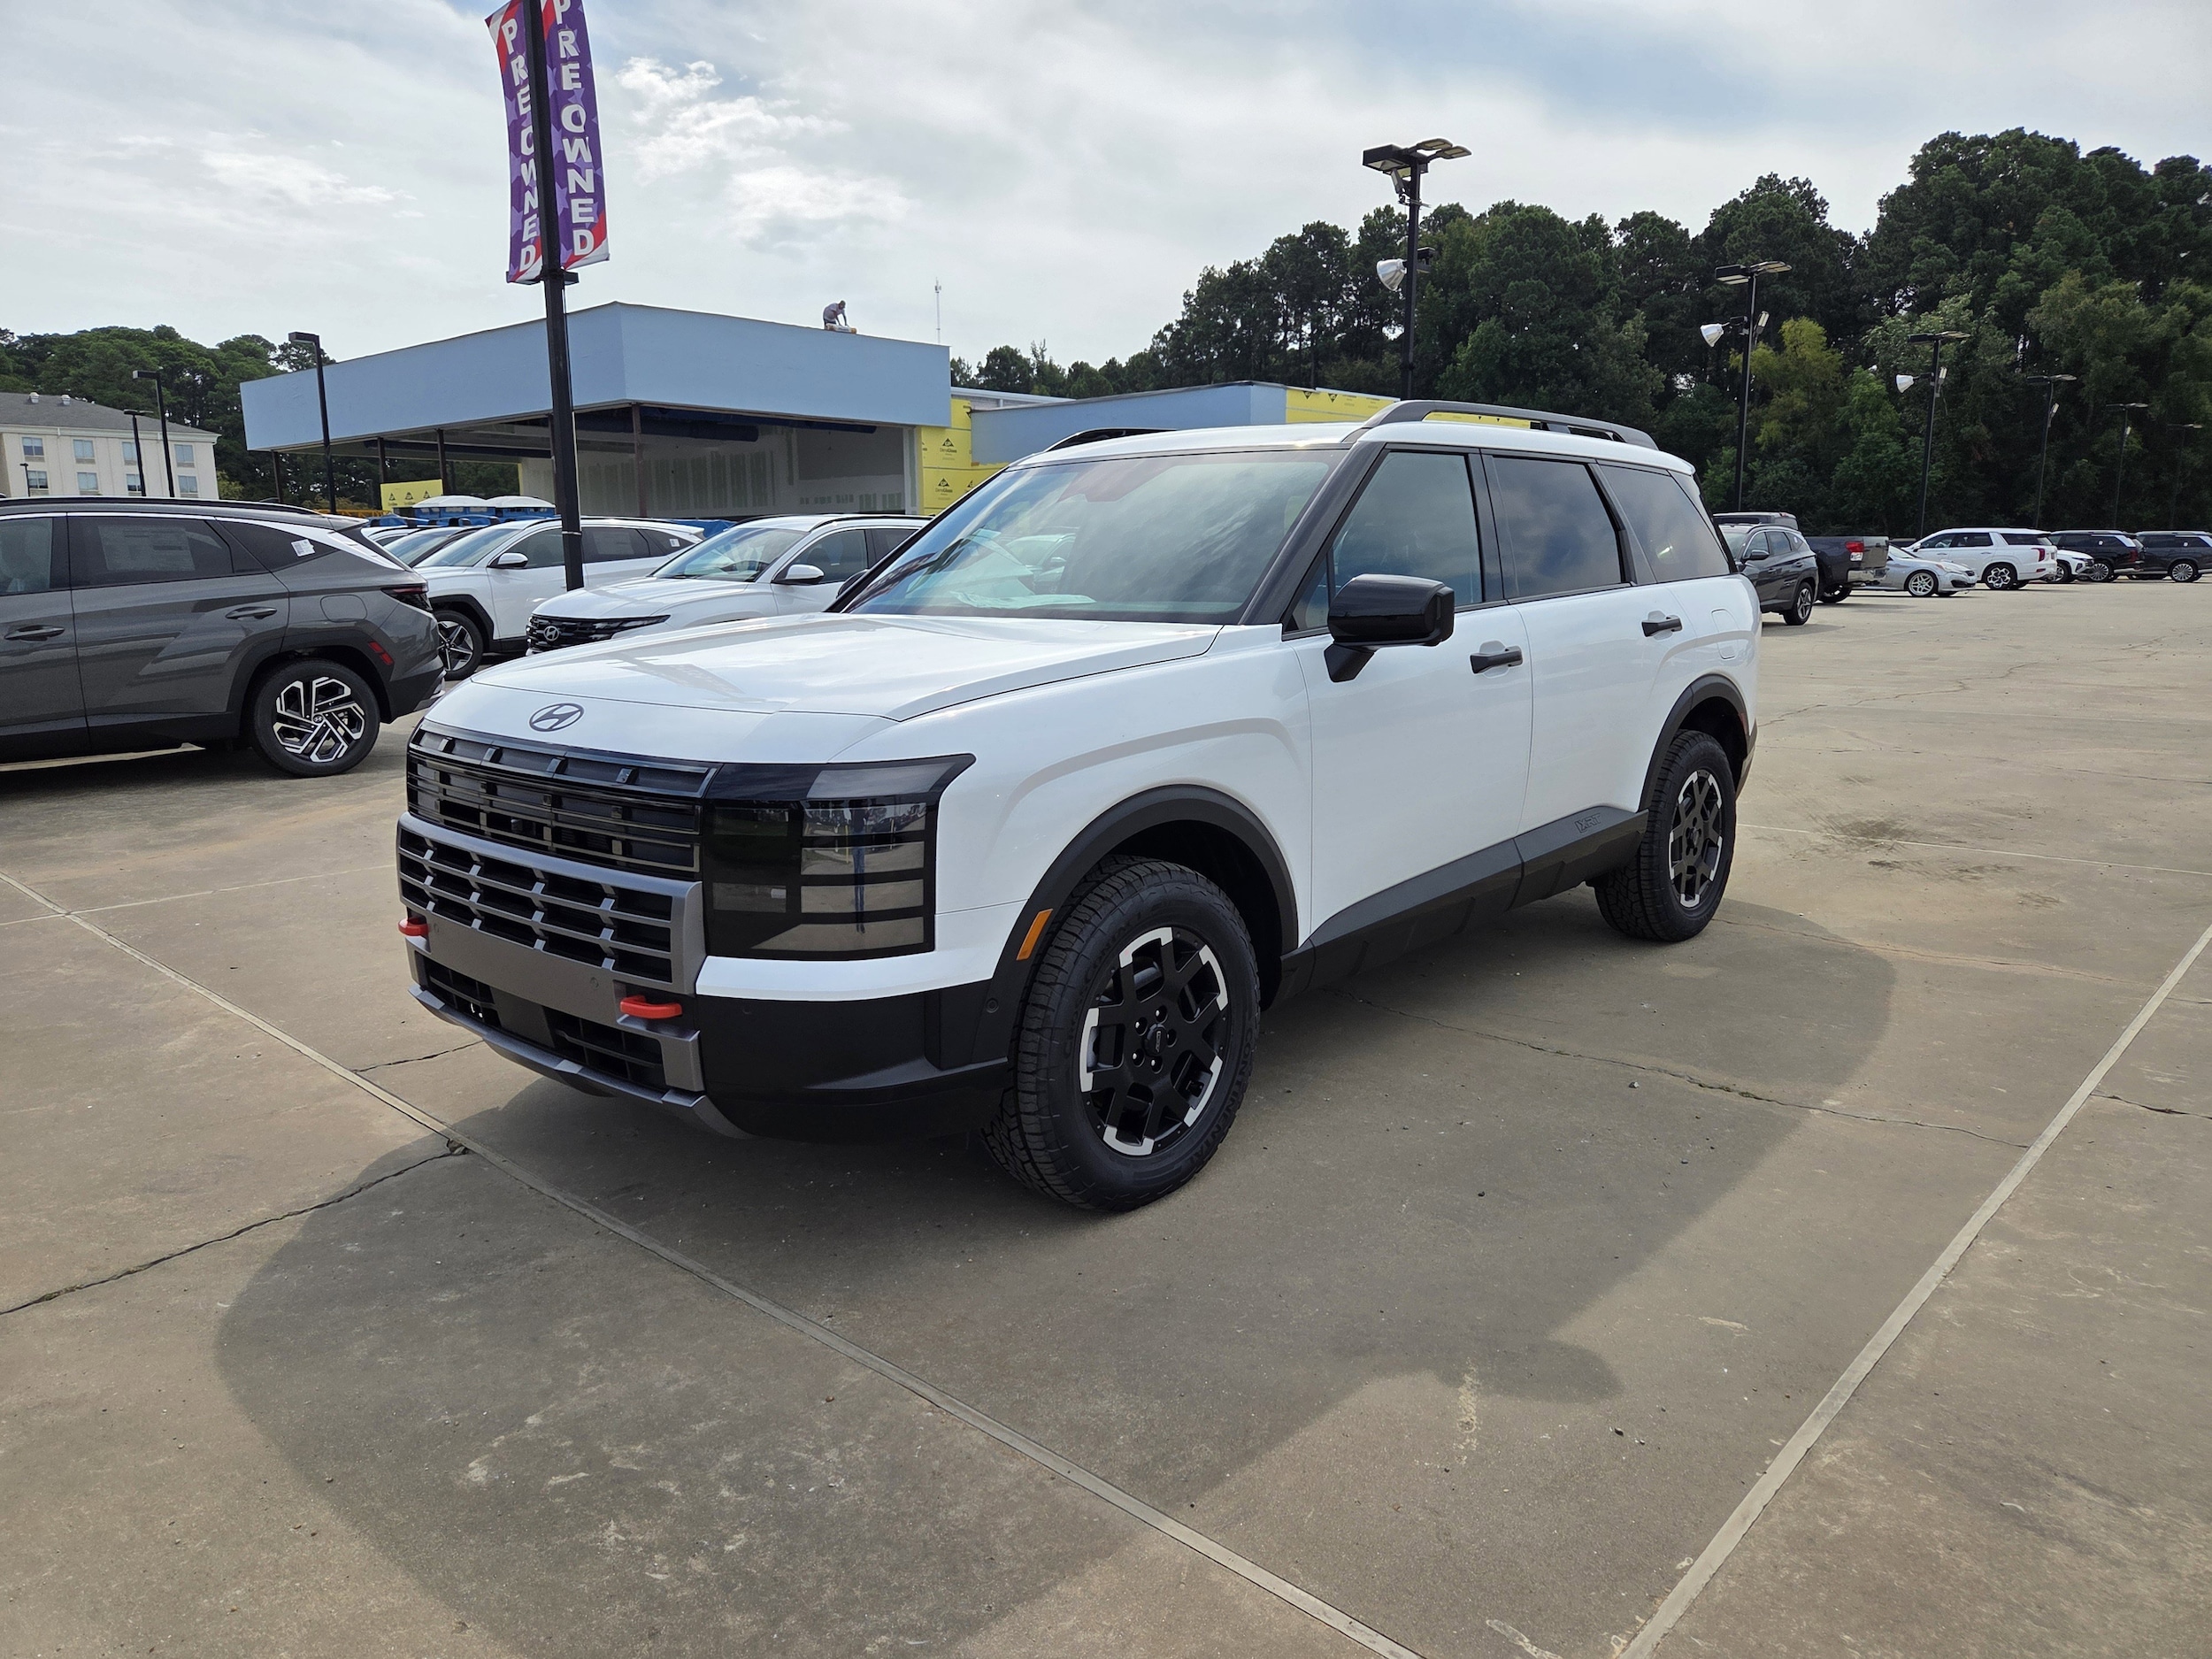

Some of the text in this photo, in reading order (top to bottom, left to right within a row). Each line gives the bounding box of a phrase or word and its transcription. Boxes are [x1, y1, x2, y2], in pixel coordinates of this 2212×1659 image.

[501, 18, 531, 116] PRE
[554, 0, 595, 257] PRE OWNED
[1576, 812, 1601, 833] XRT
